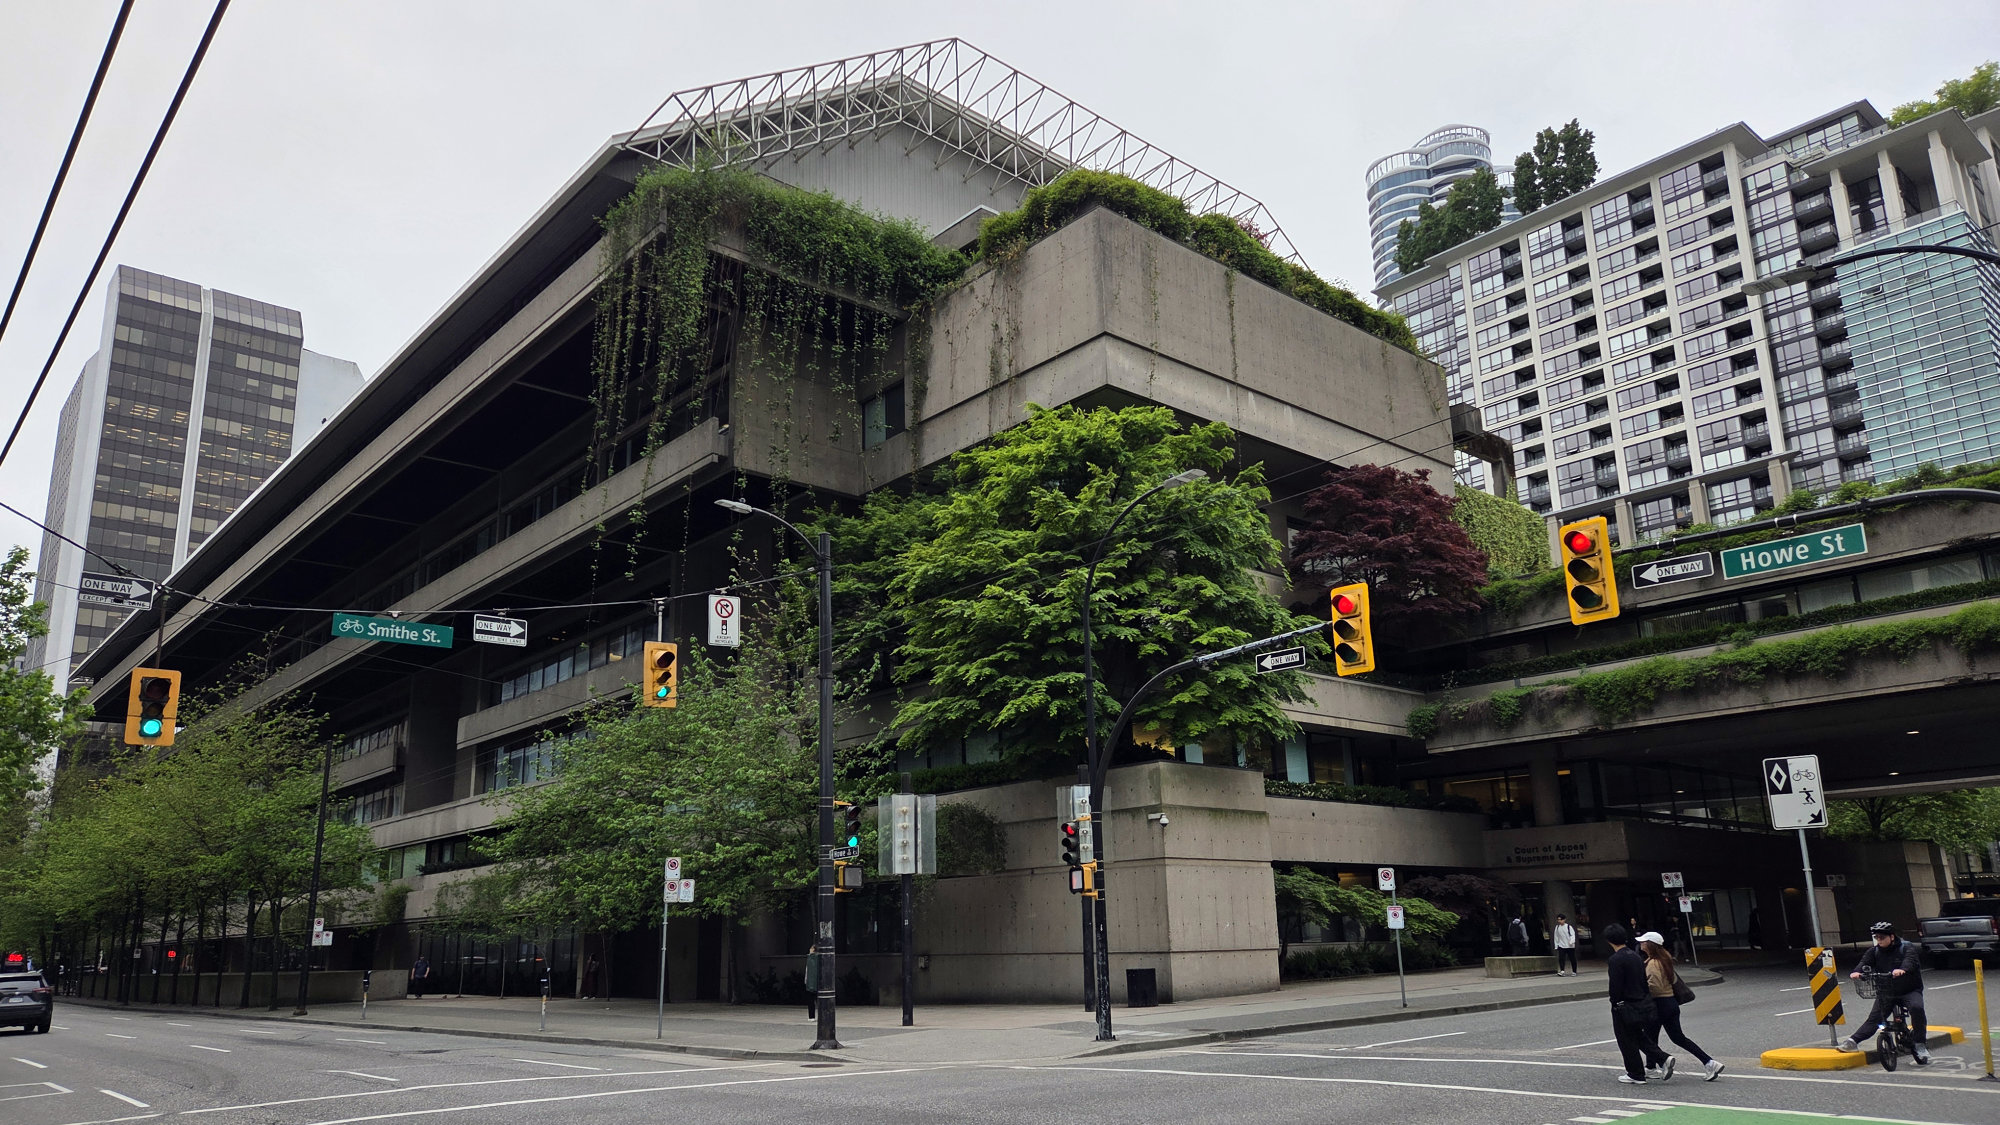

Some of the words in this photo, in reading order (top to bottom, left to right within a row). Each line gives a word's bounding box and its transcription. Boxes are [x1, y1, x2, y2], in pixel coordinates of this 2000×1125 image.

[1740, 543, 1809, 571] Howe
[1820, 533, 1846, 555] St
[1656, 566, 1677, 577] ONE
[1680, 561, 1701, 573] WAY
[84, 579, 106, 590] ONE
[111, 582, 133, 593] WAY
[82, 594, 107, 602] EXCEPT
[367, 622, 419, 641] Smithe
[421, 628, 441, 643] St.
[477, 621, 493, 630] ONE
[496, 623, 511, 632] WAY
[1270, 656, 1282, 665] ONE
[1285, 654, 1298, 662] WAY
[1514, 846, 1539, 855] Court
[1542, 845, 1552, 853] of
[1555, 842, 1588, 853] Appeal
[1515, 854, 1555, 864] Supreme
[1558, 852, 1585, 861] Court
